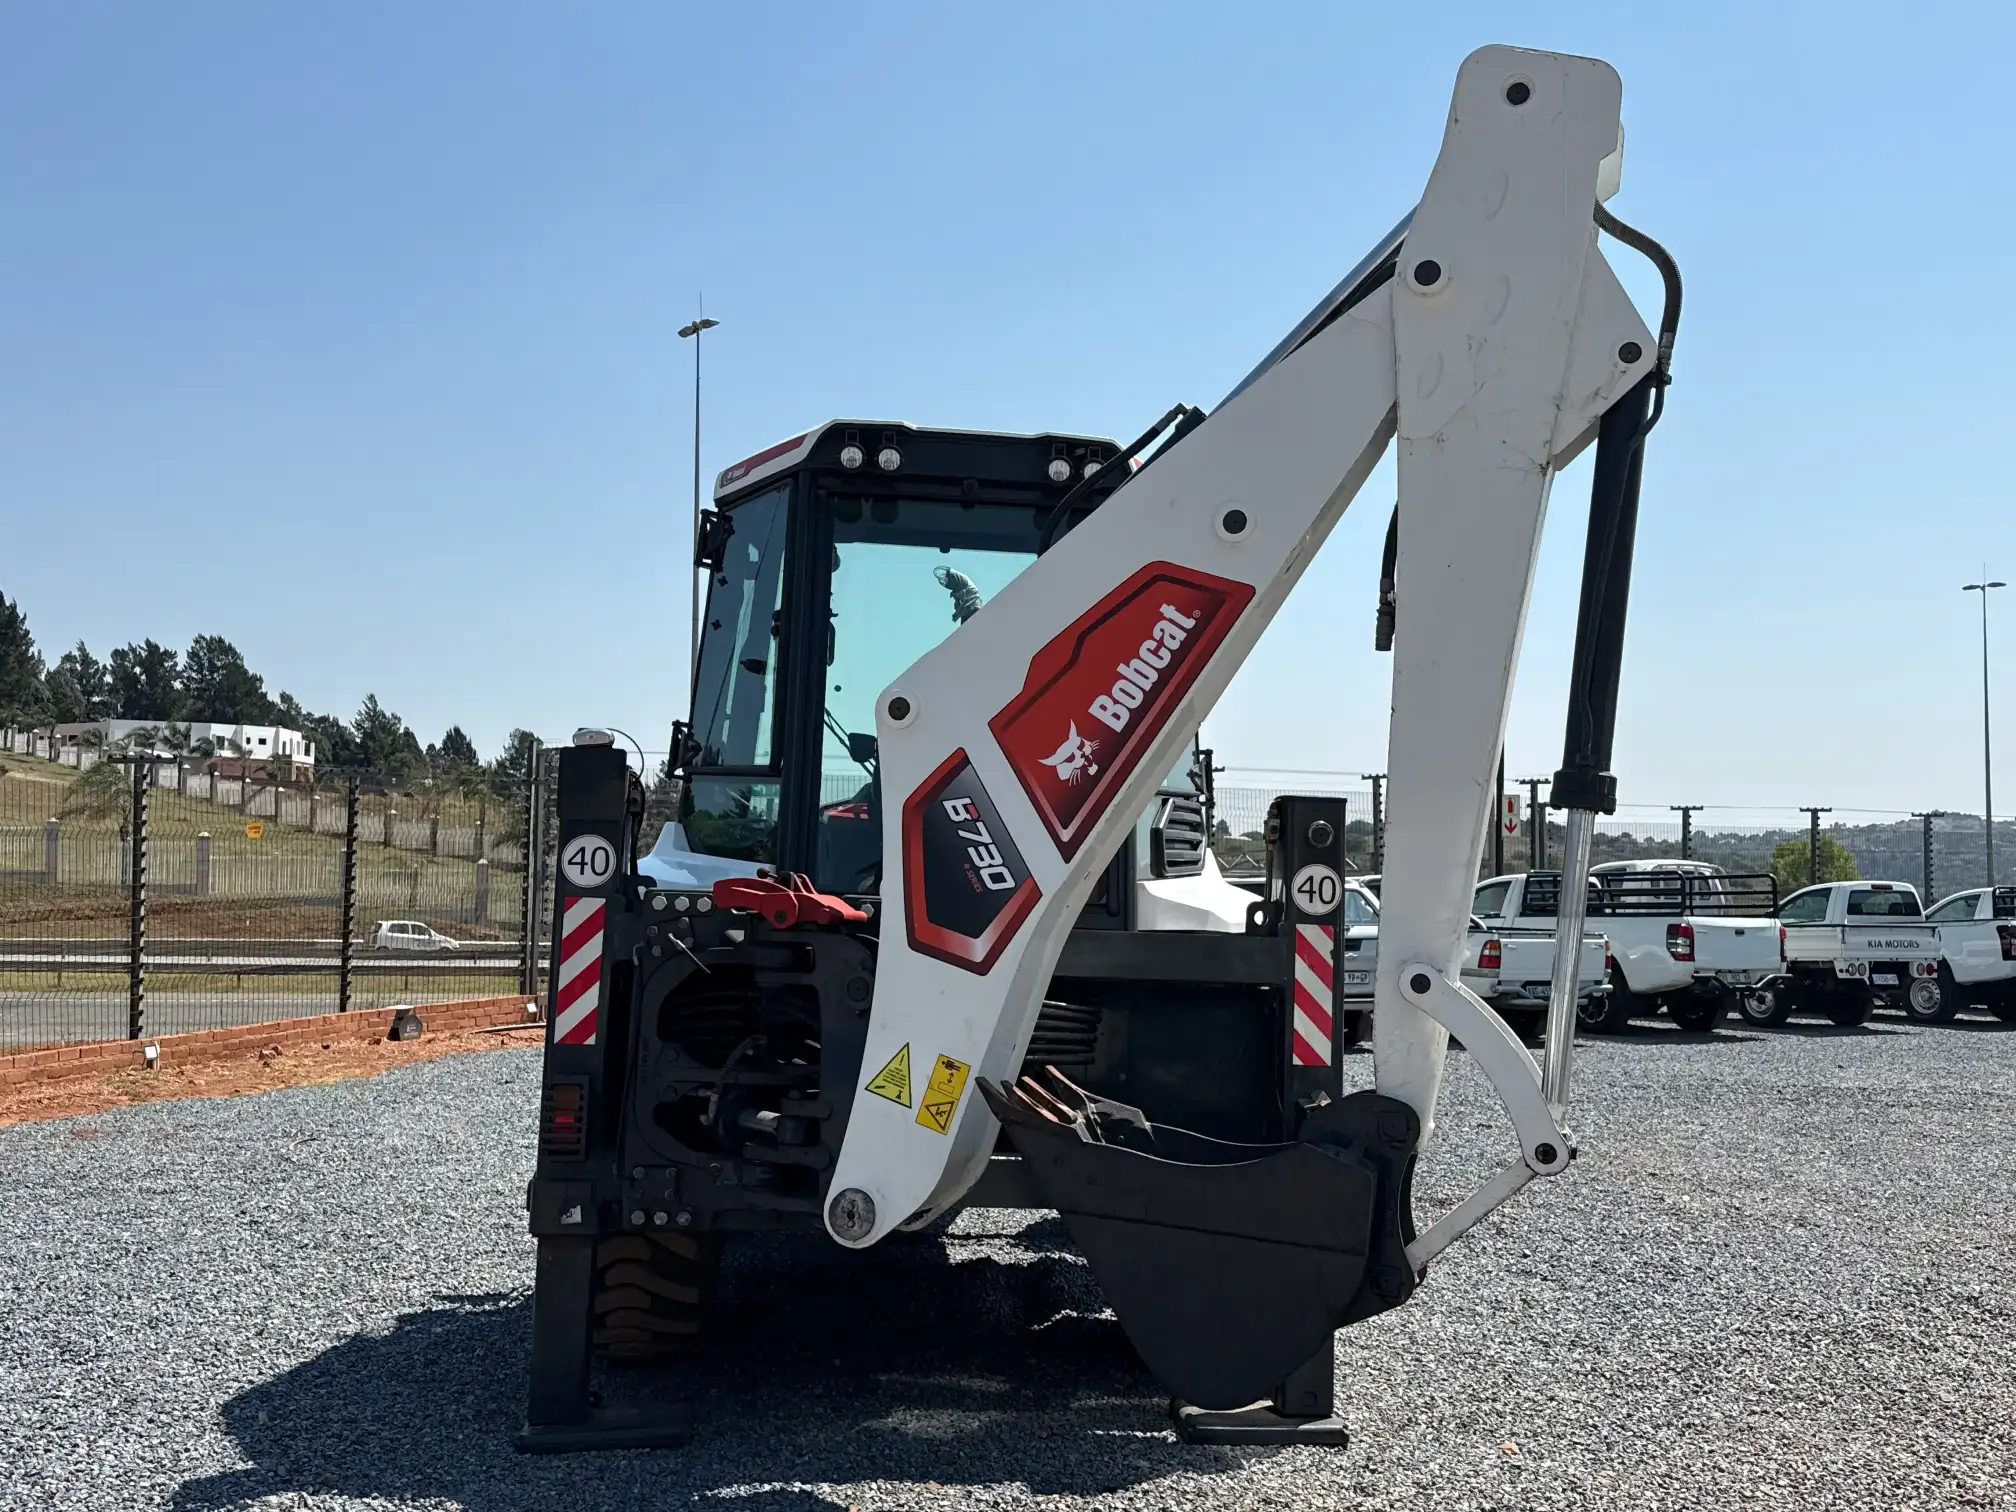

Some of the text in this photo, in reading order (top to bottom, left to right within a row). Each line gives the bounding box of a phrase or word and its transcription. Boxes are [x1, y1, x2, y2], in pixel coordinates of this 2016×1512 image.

[1088, 603, 1196, 733] Bobcat
[942, 797, 1016, 890] B730
[567, 846, 610, 876] 40
[1297, 875, 1337, 904] 40
[1867, 939, 1920, 949] KIA MOTORS
